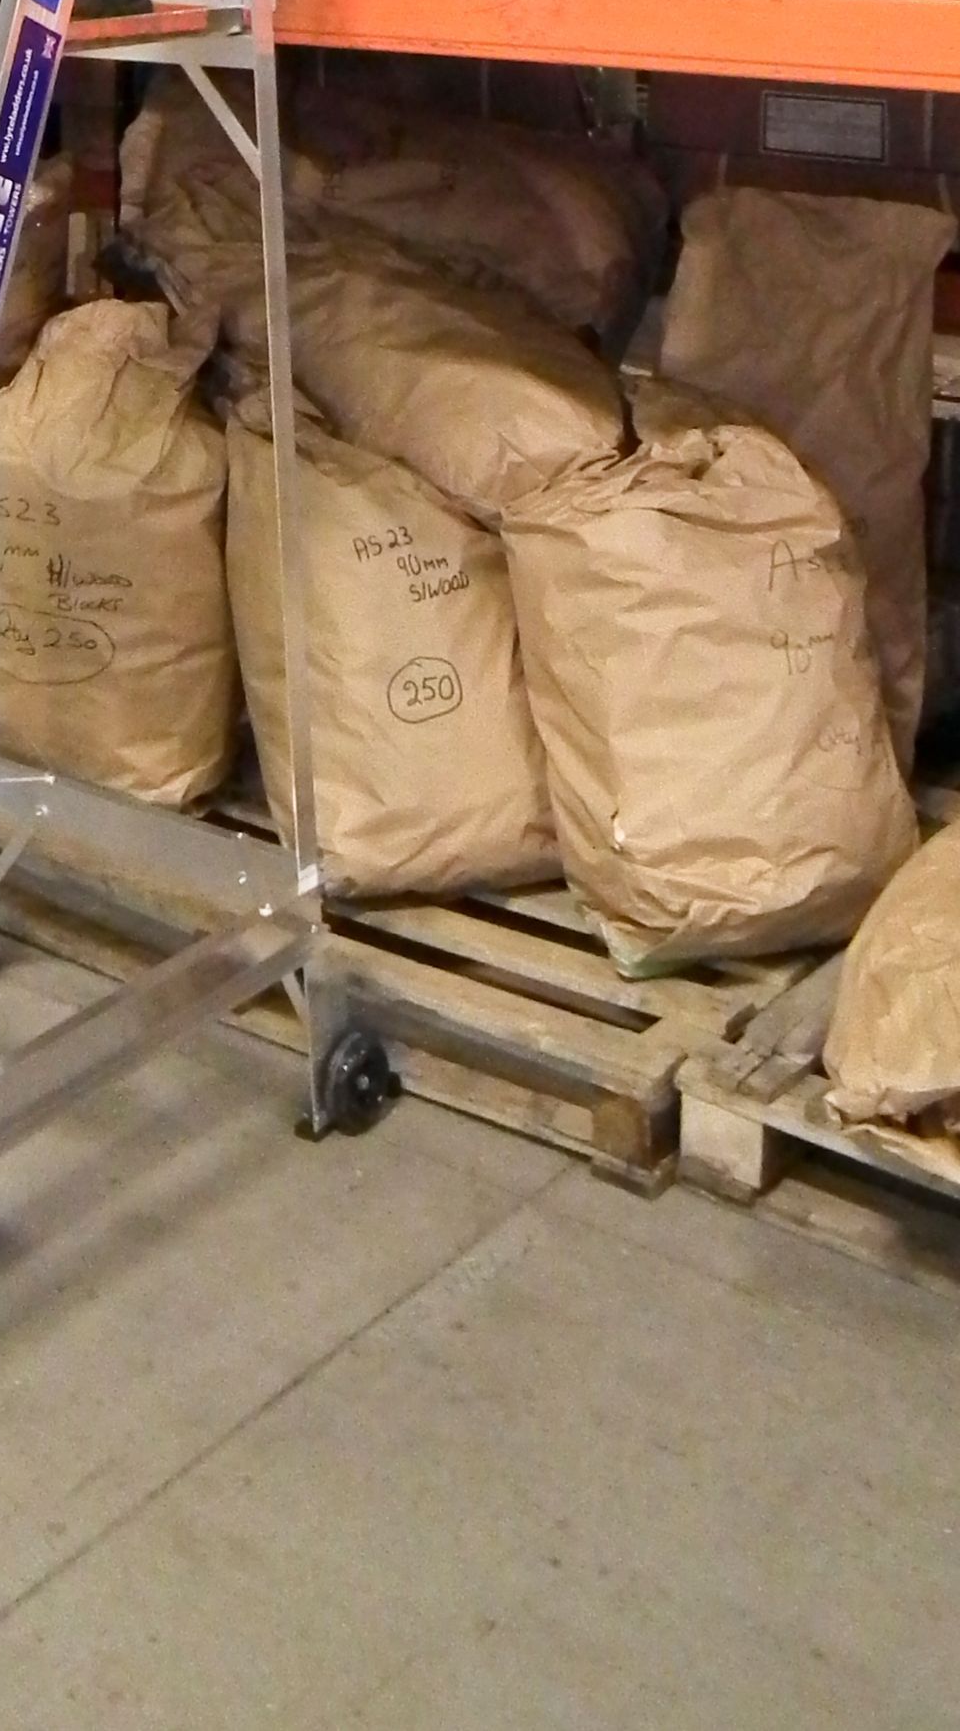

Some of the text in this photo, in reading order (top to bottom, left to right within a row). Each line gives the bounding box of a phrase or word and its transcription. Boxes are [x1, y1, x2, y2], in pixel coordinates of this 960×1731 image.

[2, 182, 22, 235] TOWERS
[42, 627, 98, 651] 250
[402, 674, 455, 707] 250
